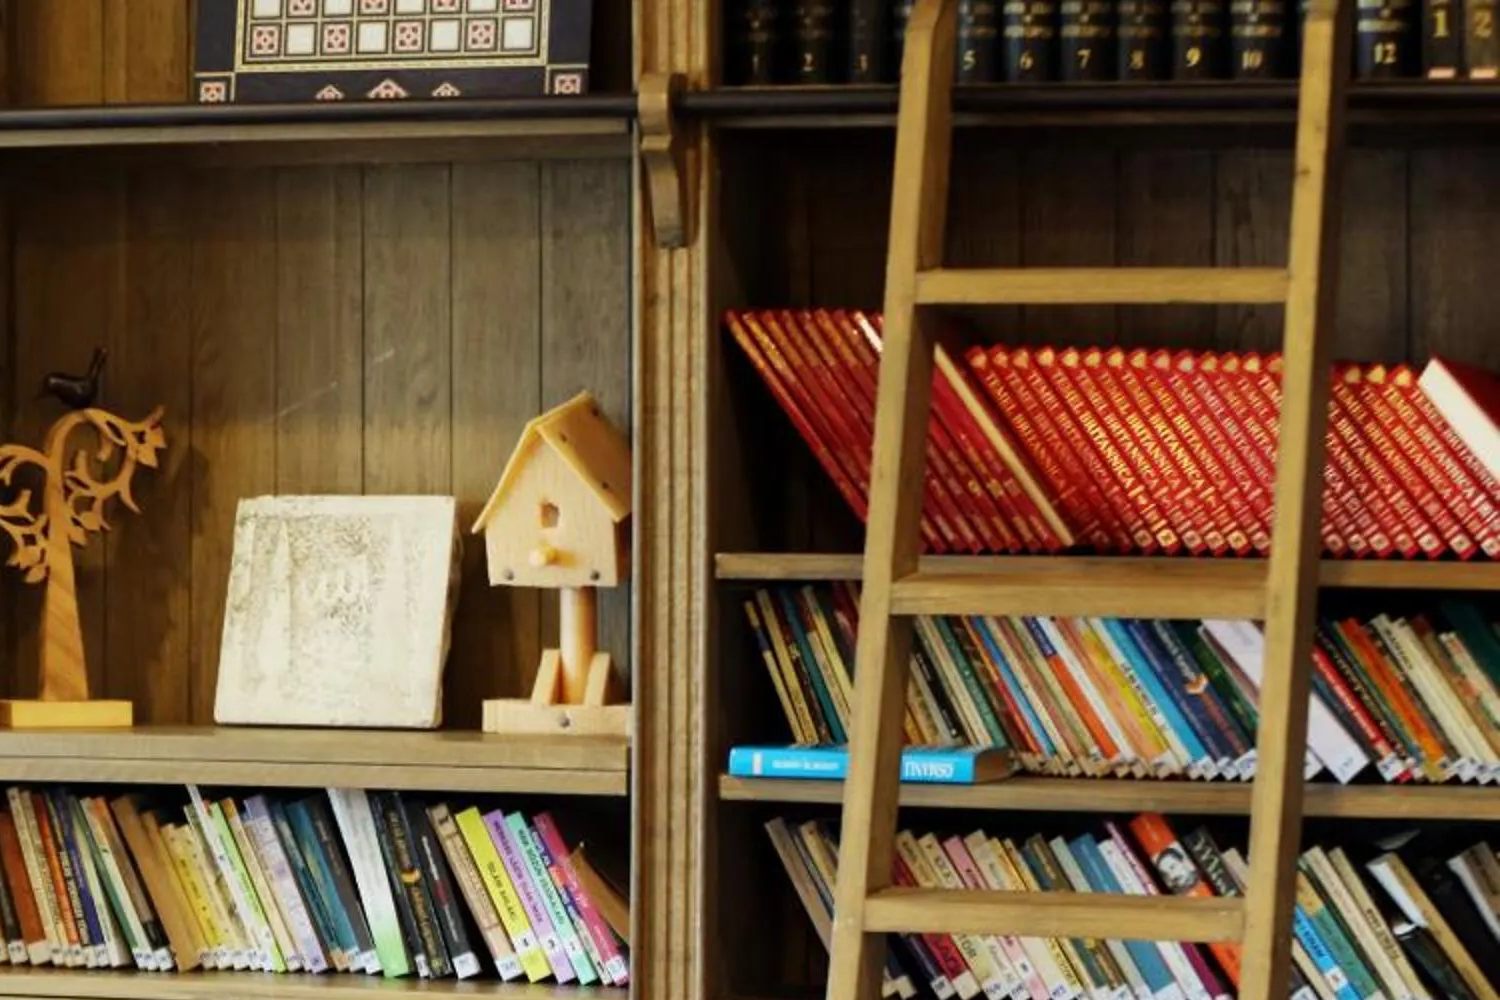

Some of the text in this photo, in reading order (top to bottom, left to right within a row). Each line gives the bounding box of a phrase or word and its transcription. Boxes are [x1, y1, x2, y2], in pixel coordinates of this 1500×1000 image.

[963, 49, 976, 70] 5
[1019, 52, 1033, 70] 6
[1077, 49, 1092, 69] 7
[1186, 47, 1201, 68] 9
[1242, 49, 1263, 70] 10
[1373, 43, 1397, 64] 12
